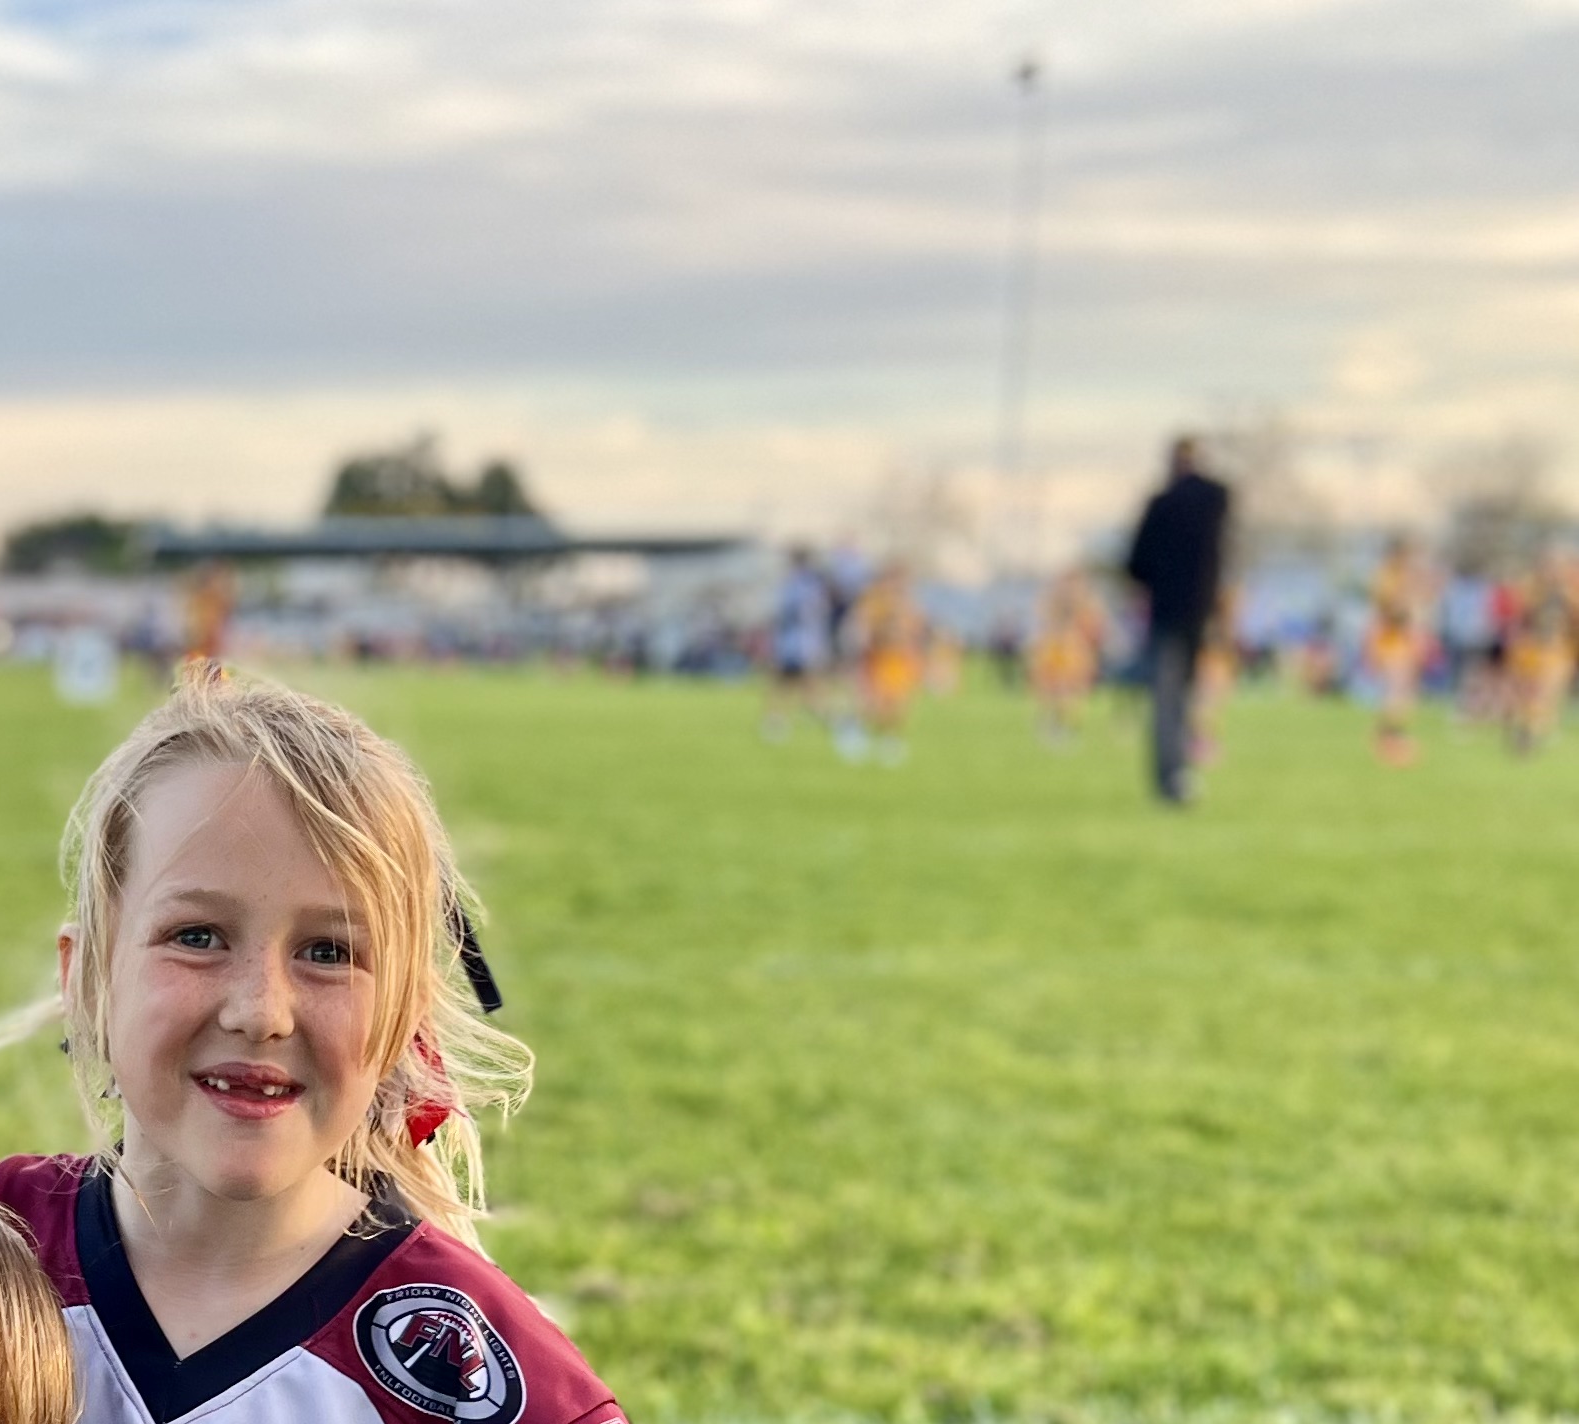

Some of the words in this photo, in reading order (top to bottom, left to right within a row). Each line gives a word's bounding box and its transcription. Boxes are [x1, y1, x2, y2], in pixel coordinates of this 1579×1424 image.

[385, 1287, 441, 1302] FRIDAY
[444, 1291, 483, 1324] NIGHT
[482, 1329, 517, 1379] LIGHTS
[395, 1313, 485, 1392] FNL
